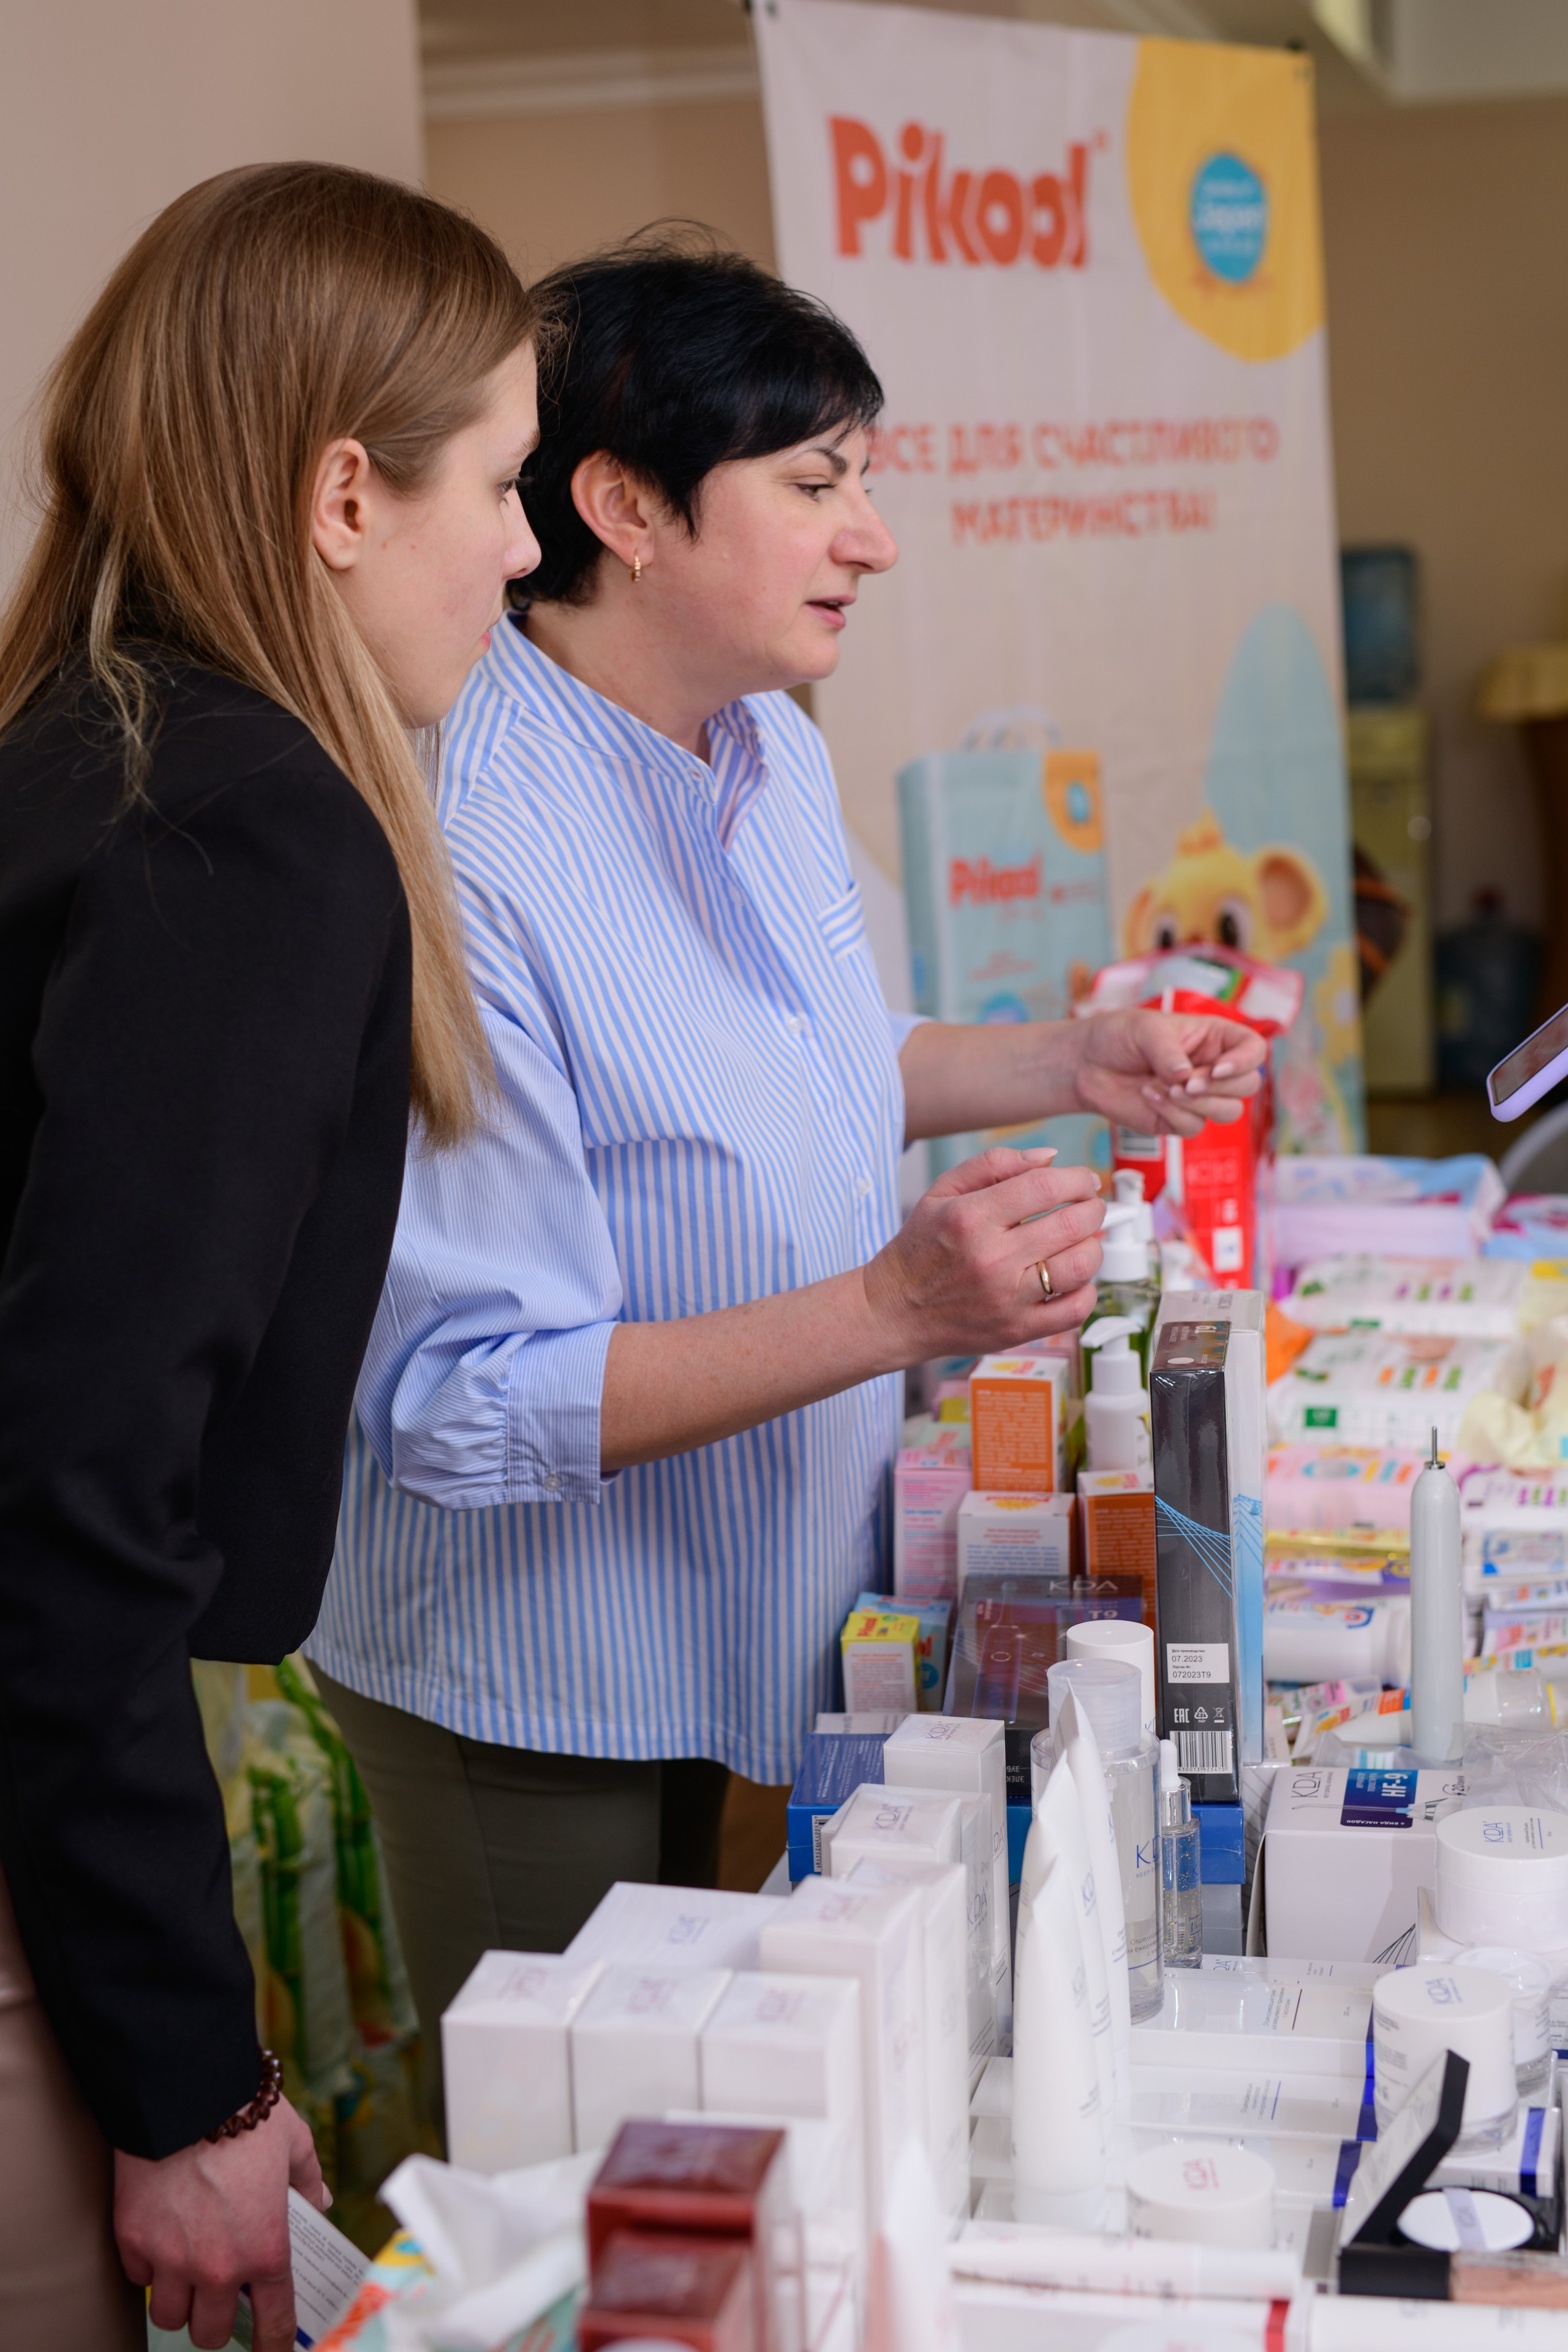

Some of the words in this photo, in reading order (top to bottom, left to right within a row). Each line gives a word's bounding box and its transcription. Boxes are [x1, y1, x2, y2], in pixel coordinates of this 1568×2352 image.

[1049, 1579, 1119, 1592] KDA
[1088, 1610, 1118, 1620] T9
[1291, 1771, 1323, 1798] KDA
[1381, 1773, 1409, 1798] HF-9
[993, 1826, 1005, 1856] DA
[1482, 1822, 1504, 1843] KDA
